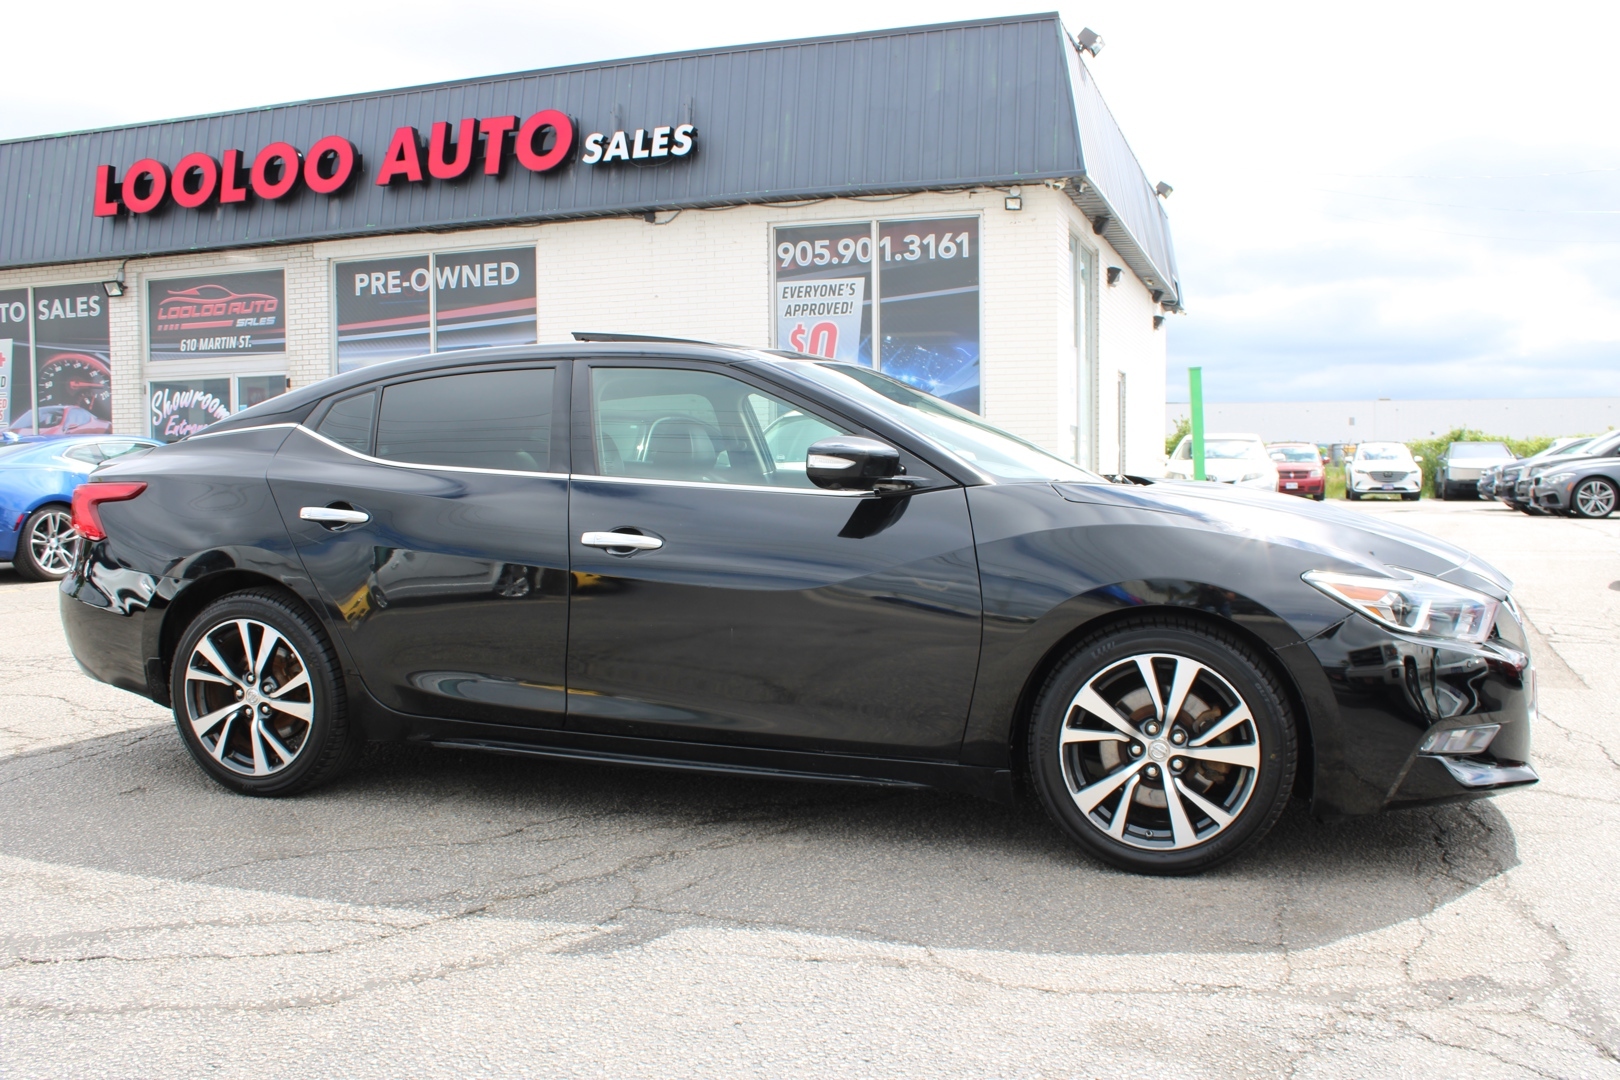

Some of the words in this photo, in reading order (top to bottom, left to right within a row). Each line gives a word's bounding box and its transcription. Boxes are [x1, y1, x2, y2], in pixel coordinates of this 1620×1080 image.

[582, 124, 695, 165] SALES
[94, 135, 353, 217] LOOLOO
[375, 109, 573, 186] AUTO
[777, 231, 970, 268] 905.901.3161
[354, 261, 520, 297] PRE-OWNED
[782, 282, 856, 300] EVERYONE'S
[38, 296, 100, 320] SALES
[158, 303, 226, 320] LOOLOO
[227, 299, 279, 315] AUTO
[784, 301, 854, 317] APPROVED!
[235, 316, 276, 328] SALES
[180, 338, 198, 352] 610
[198, 336, 237, 350] MARTIN
[238, 335, 252, 348] ST.
[151, 388, 231, 426] Showroom
[164, 414, 208, 436] Entra
